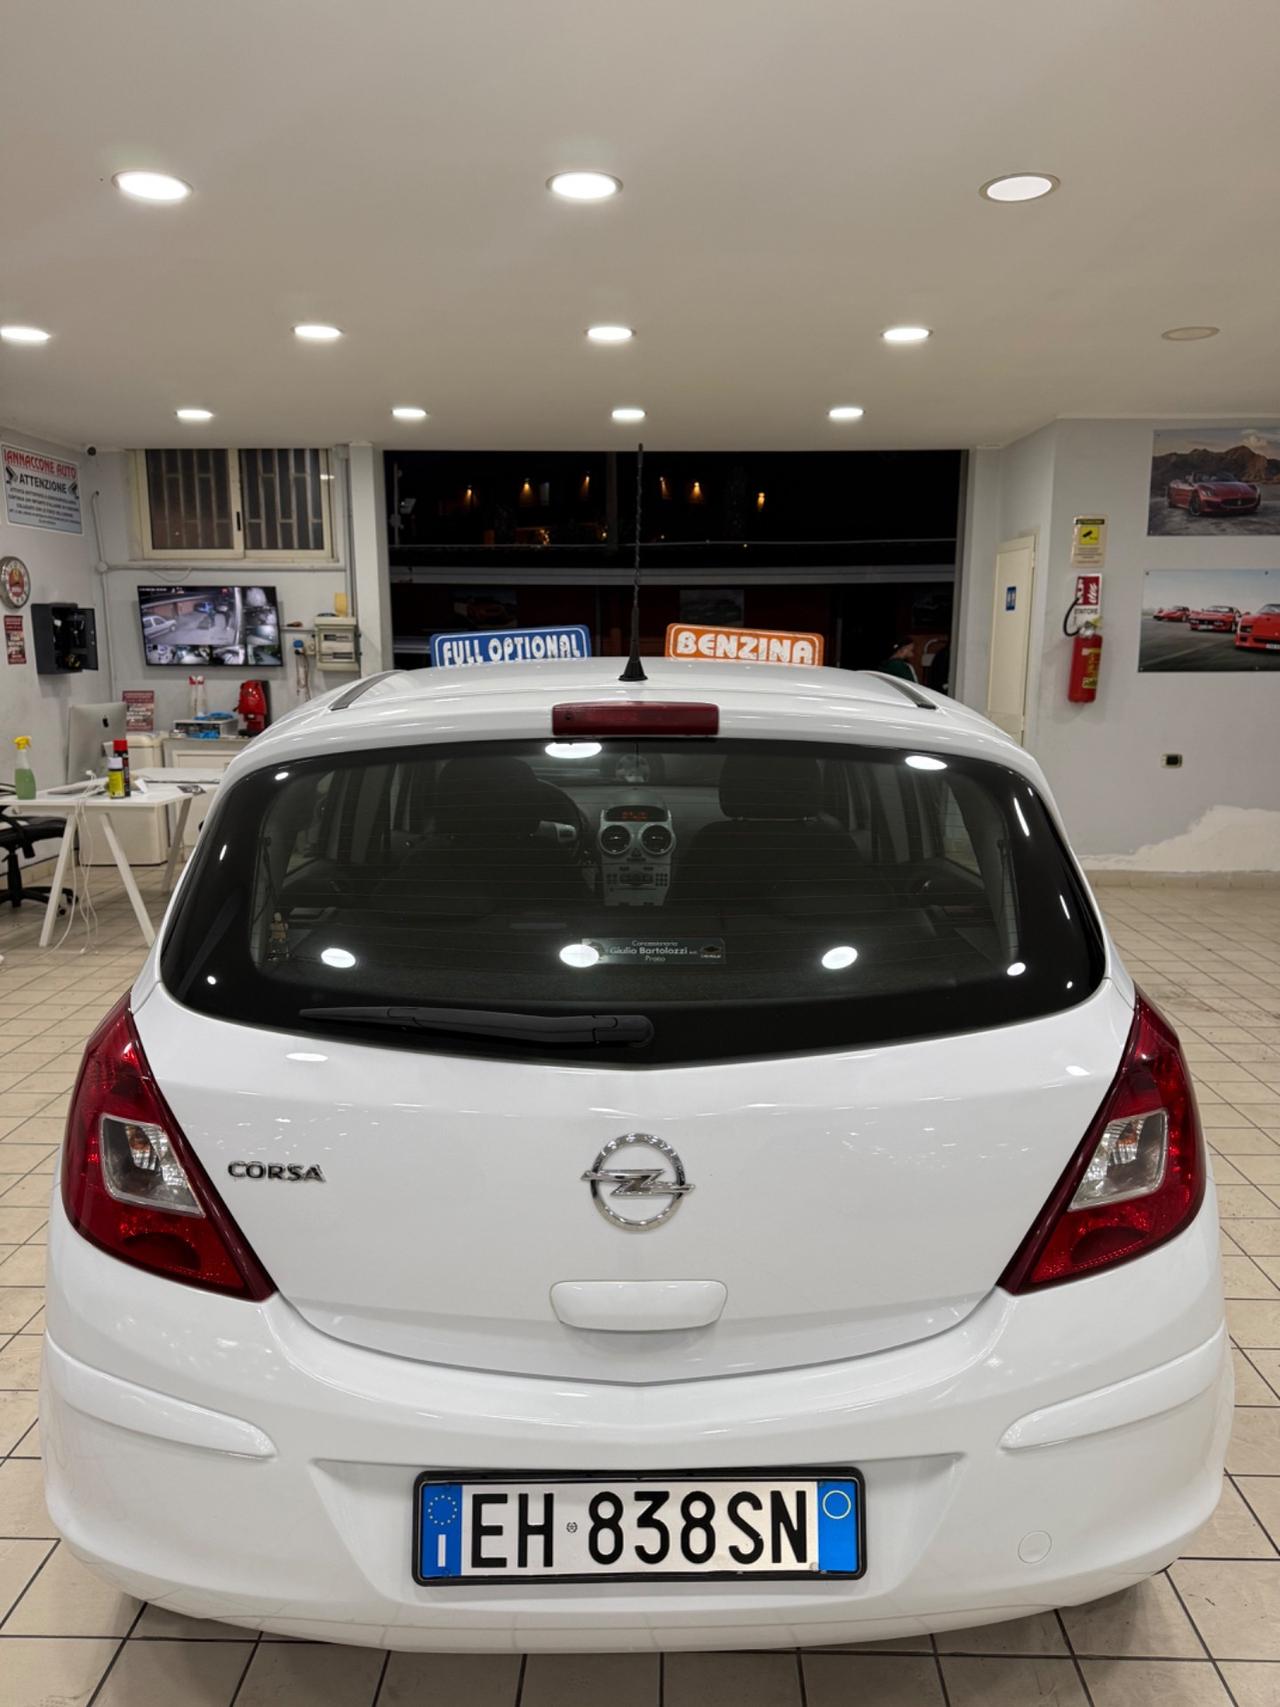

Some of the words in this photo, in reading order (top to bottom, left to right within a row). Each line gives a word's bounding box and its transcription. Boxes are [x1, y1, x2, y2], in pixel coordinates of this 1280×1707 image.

[19, 473, 67, 494] ATTENZIONE
[56, 463, 77, 479] AUTO
[443, 640, 483, 667] FULL
[488, 634, 581, 662] OPTIONAL
[676, 630, 813, 664] BENZINA
[228, 1160, 326, 1183] CORSA
[471, 1492, 554, 1569] EH
[588, 1489, 807, 1566] 838SN
